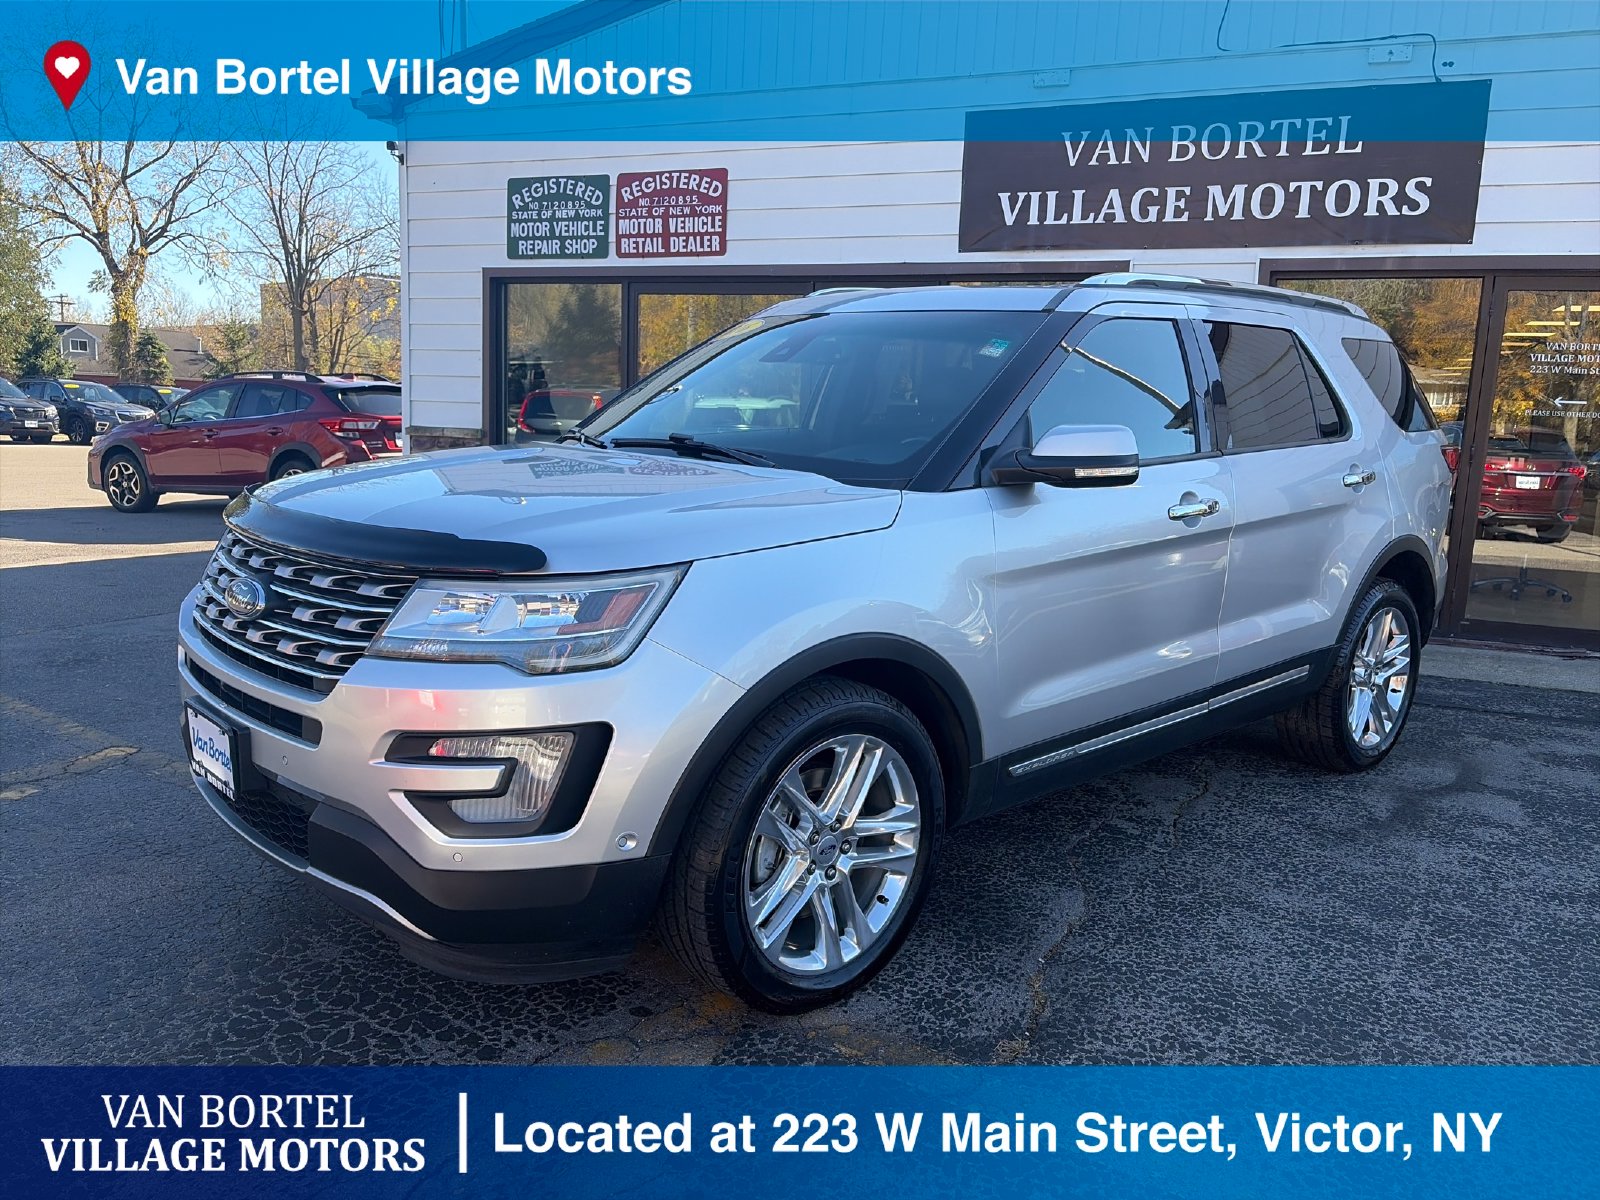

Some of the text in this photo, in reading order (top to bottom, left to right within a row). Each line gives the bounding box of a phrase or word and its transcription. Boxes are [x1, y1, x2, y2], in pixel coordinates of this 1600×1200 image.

[1061, 115, 1363, 167] VAN BORTEL
[512, 178, 603, 209] REGISTERED
[621, 173, 722, 202] REGISTERED
[542, 200, 586, 209] 7120895
[653, 195, 698, 205] 7120895
[998, 176, 1433, 226] VILLAGE MOTORS
[512, 208, 603, 219] STATE OF NEW YORK
[619, 205, 722, 217] STATE OF NEW YORK
[511, 221, 605, 237] MOTOR VEHICLE
[619, 216, 722, 234] MOTOR VEHICLE
[519, 239, 597, 255] REPAIR SHOP
[621, 235, 720, 253] RETAIL DEALER
[1546, 342, 1567, 350] VAN
[1530, 354, 1575, 362] VILLAGE
[1530, 365, 1548, 374] 223
[1551, 366, 1561, 374] W
[1564, 367, 1588, 375] Main
